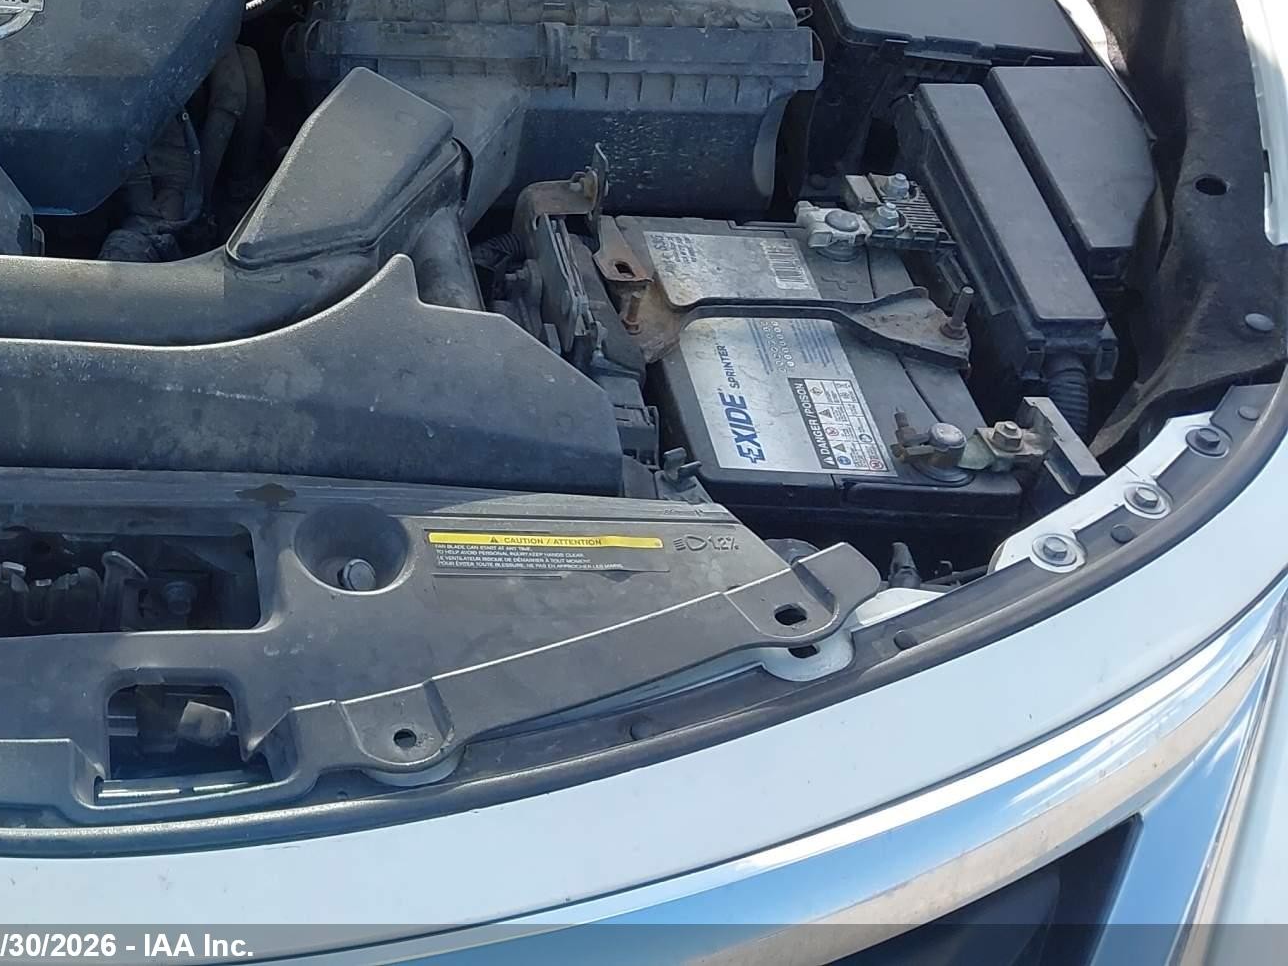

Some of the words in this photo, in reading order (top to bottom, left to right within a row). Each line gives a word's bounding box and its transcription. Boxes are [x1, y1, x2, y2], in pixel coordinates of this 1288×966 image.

[717, 344, 740, 390] SPRINTER
[719, 392, 766, 464] EXIDE
[808, 420, 831, 463] DANGER
